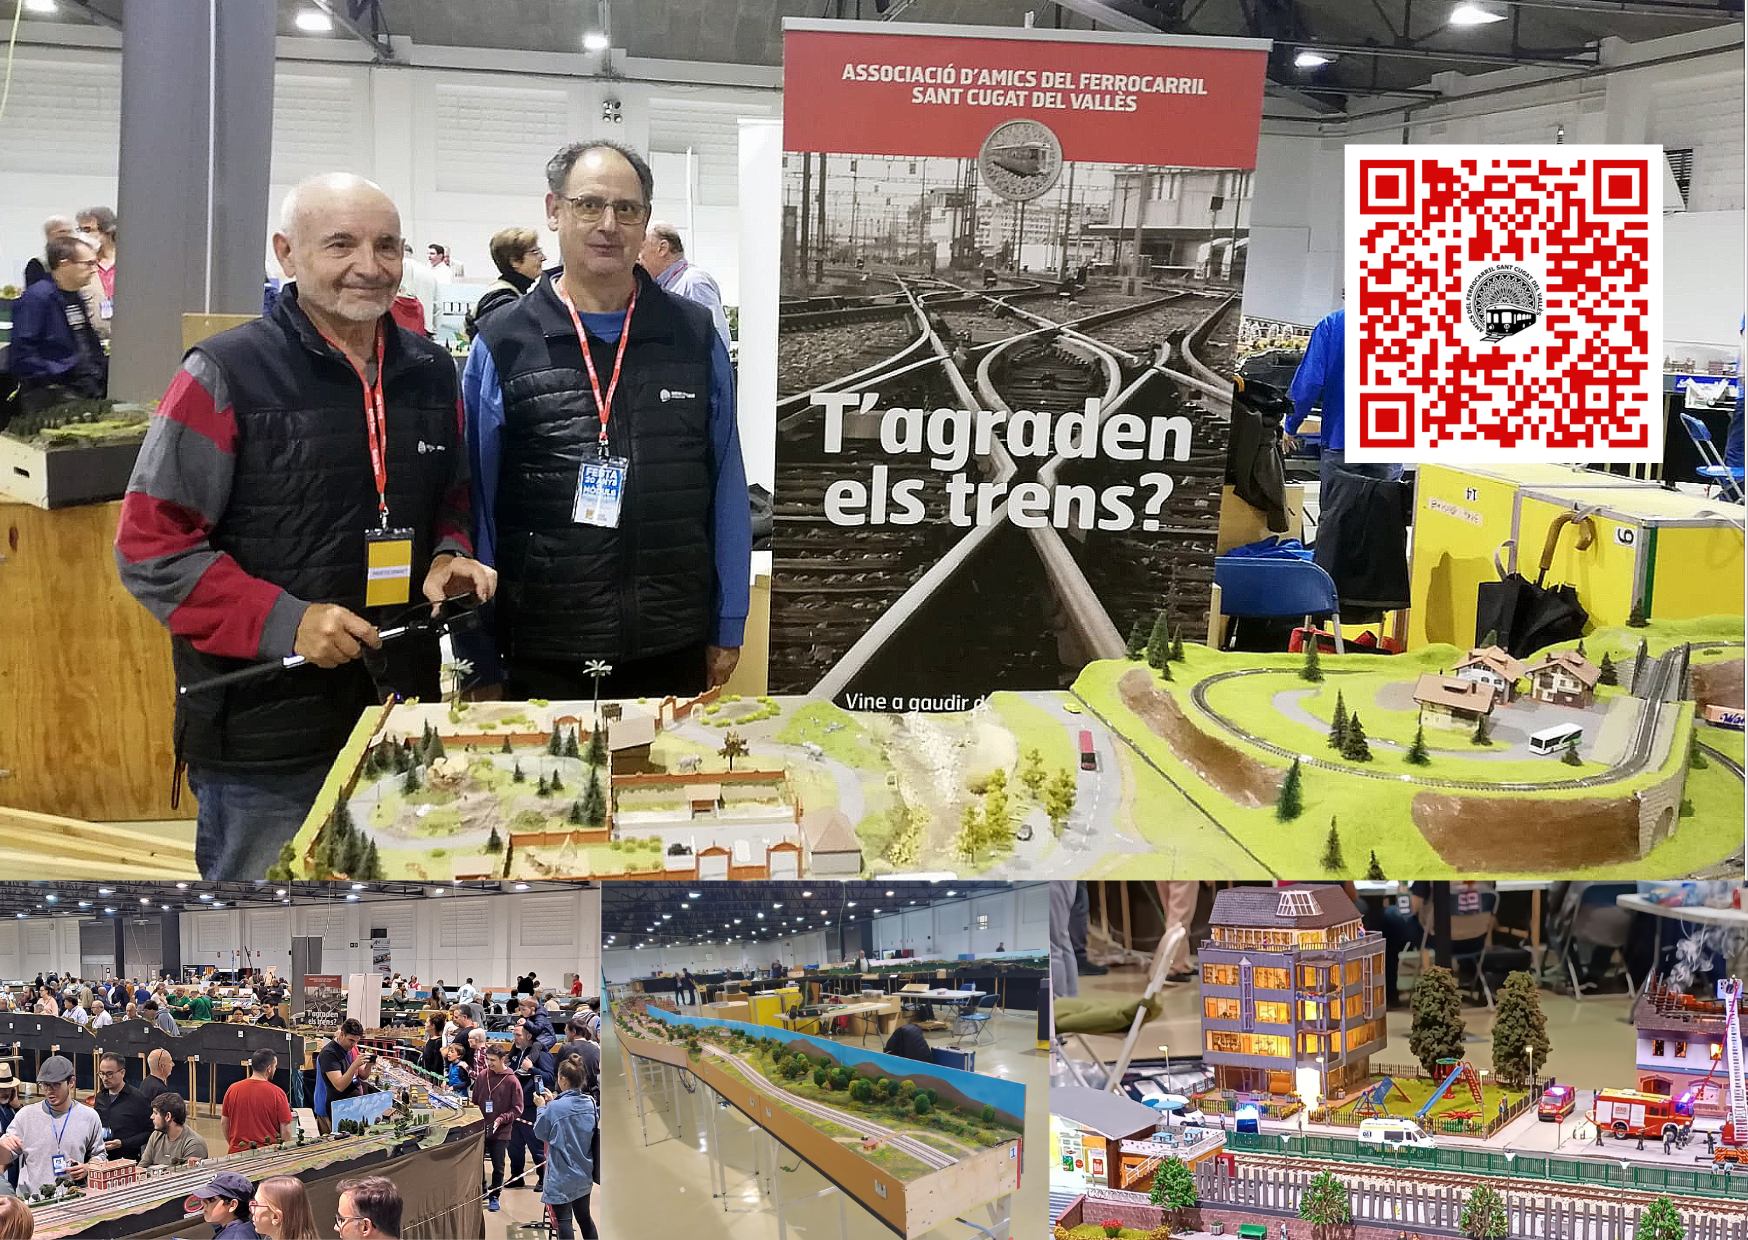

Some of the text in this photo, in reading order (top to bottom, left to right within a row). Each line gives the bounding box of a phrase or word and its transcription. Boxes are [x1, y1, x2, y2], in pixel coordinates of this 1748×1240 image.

[842, 63, 1208, 95] ASSOCIACIÓ D'AMICS DEL FERROCARRIL
[912, 87, 1137, 112] SANT CUGAT DEL VALLÈS
[810, 392, 1193, 472] T'agraden
[586, 467, 617, 479] FESTA
[824, 465, 1174, 532] els trens?
[846, 693, 886, 709] Vine
[892, 697, 903, 709] a
[909, 694, 969, 711] gaudir
[1011, 1147, 1016, 1158] 1
